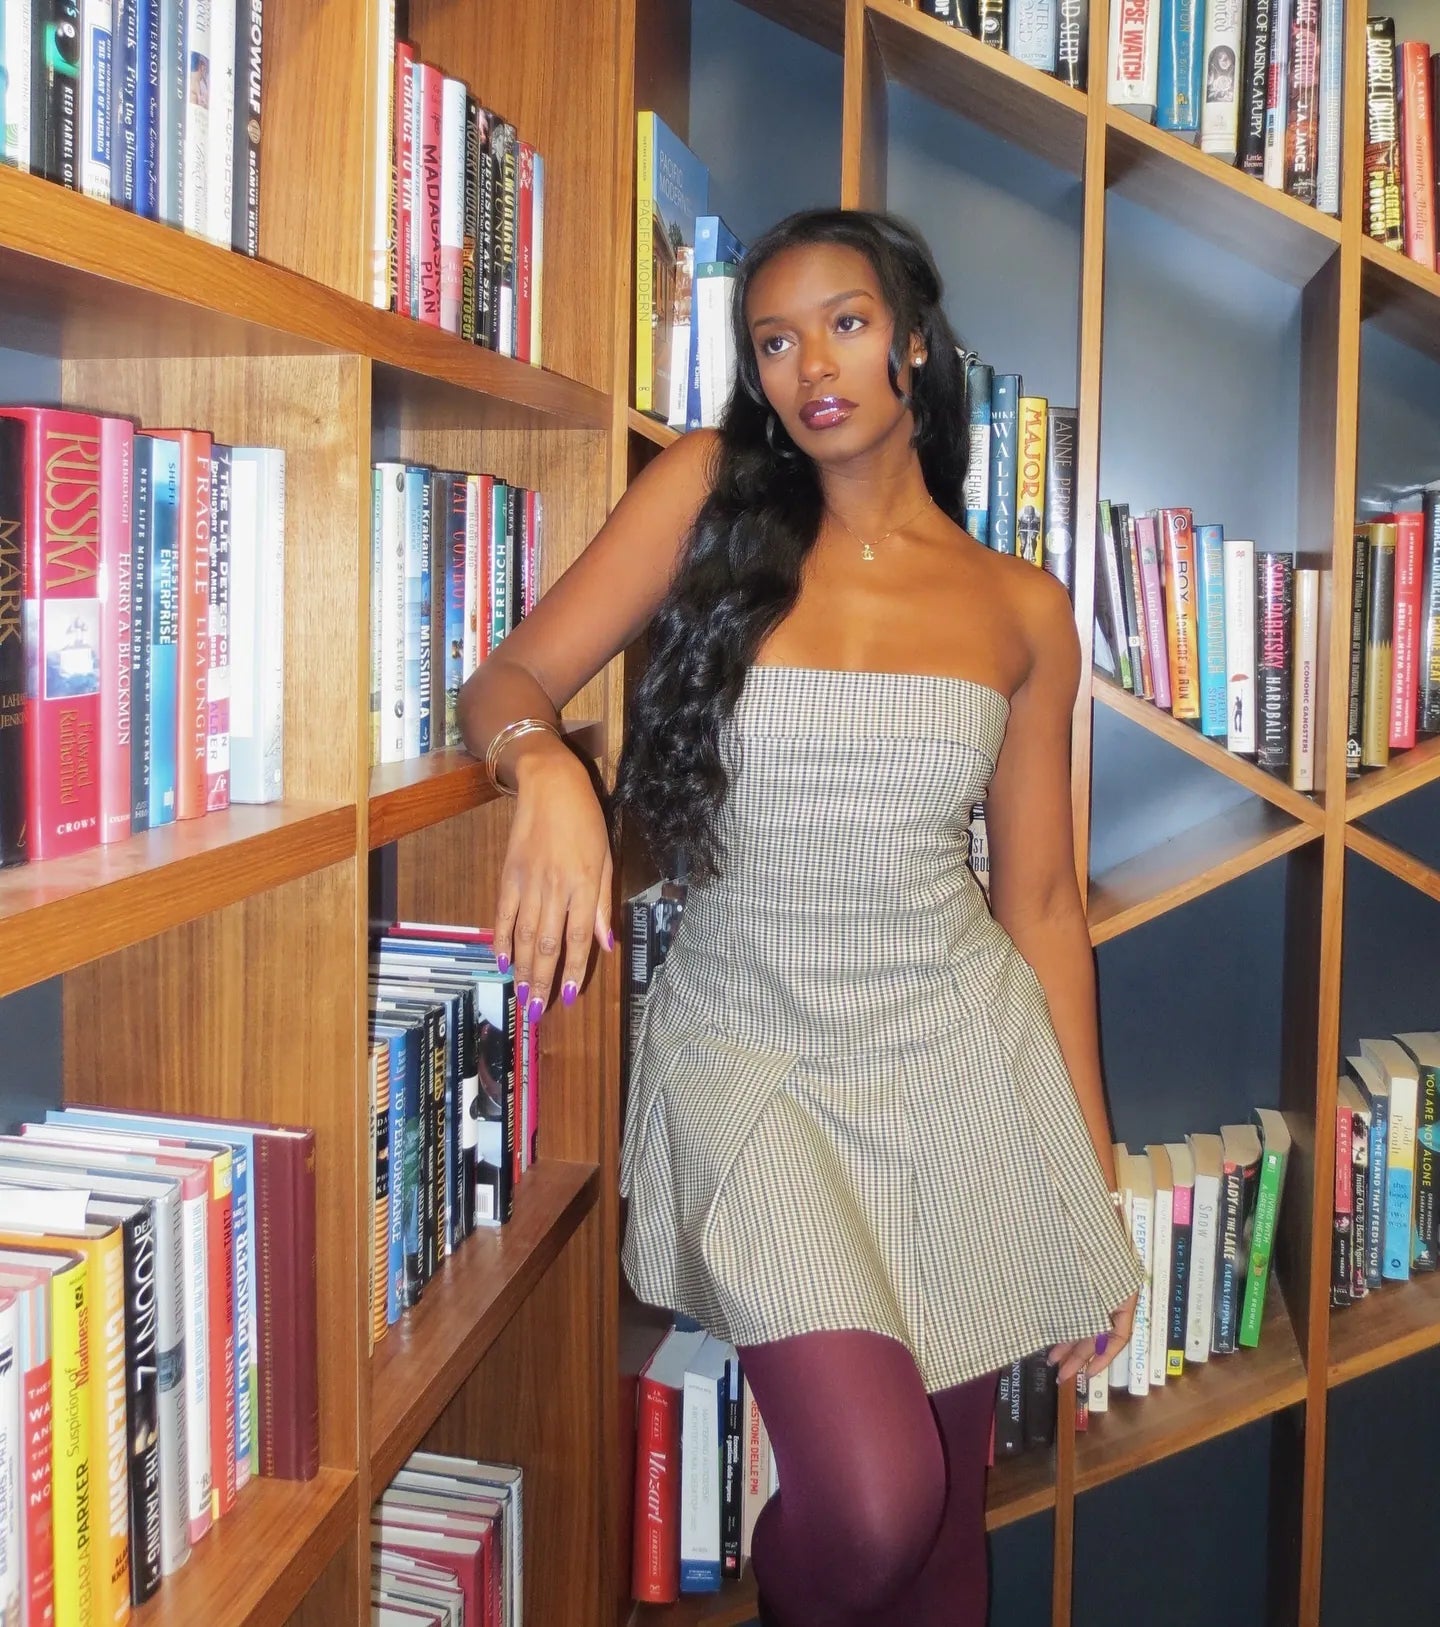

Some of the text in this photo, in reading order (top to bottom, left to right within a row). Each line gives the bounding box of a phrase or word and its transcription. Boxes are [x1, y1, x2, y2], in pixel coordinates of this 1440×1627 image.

[97, 39, 106, 60] THE
[97, 62, 106, 93] HEART
[249, 0, 262, 114] BEOWULF
[1059, 22, 1080, 64] SLEEP
[1122, 30, 1142, 82] WATCH
[1249, 13, 1267, 139] OF RAISING A PUPPY
[63, 86, 74, 160] REED FARREL
[96, 110, 106, 154] AMERICA
[124, 66, 137, 201] Pity the Billionaire
[402, 57, 412, 211] A CHANCE TO WIN
[1416, 82, 1426, 120] KARON
[248, 150, 258, 204] SEAMUS
[1294, 129, 1307, 173] JANCE
[423, 145, 441, 312] MADAGASK
[484, 154, 492, 231] DECISION
[421, 262, 437, 314] PLAN
[484, 249, 491, 271] AT
[638, 199, 651, 323] PACIFIC MODERN
[991, 410, 1016, 420] MIKE
[966, 467, 982, 510] LEHANE
[992, 423, 1014, 554] WALLACE
[1020, 406, 1042, 500] MAJOR
[1055, 421, 1073, 527] ANNE PERRY
[45, 431, 101, 590] RUSSKA
[219, 471, 231, 553] THE LIE
[421, 509, 430, 574] Krakauer
[0, 517, 23, 645] MARK
[117, 441, 132, 746] YARBROUGH HARRY A. BLACKMUN
[132, 467, 148, 671] NEXT LIFE MIGHT BE KINDER
[159, 549, 172, 646] ENTERPRISE
[170, 551, 178, 645] RESILIENT
[495, 544, 506, 618] FRENCH
[1175, 560, 1190, 603] BOX
[194, 456, 210, 761] FRAGILE LISA UNGER
[1174, 612, 1190, 661] NOWHERE
[1205, 590, 1226, 675] EVANOVICH
[1264, 597, 1286, 669] PARETSKY
[420, 625, 431, 719] MISSOULA
[1176, 678, 1190, 700] RUN
[1301, 660, 1310, 753] ECONOMIC GANGSTERS
[1394, 602, 1407, 739] THE MAN WHO WASN'T THERE
[1264, 676, 1282, 742] HARDBALL
[56, 815, 97, 836] CROWN
[394, 1087, 406, 1111] TO
[1421, 1073, 1435, 1187] YOU ARE NOT ALONE
[392, 1115, 405, 1244] PERFORMANCE
[1370, 1138, 1384, 1266] THE HAND THAT FEEDS YOU
[223, 1208, 233, 1249] THAT?
[1223, 1175, 1240, 1259] LADY IN THE LAKE
[1254, 1192, 1268, 1248] GREEN HEART
[1263, 1193, 1275, 1243] LIVING WITH
[1354, 1173, 1366, 1268] Inside Out Back Again
[236, 1229, 250, 1349] PROSPER
[1219, 1263, 1235, 1337] LAURA LIPPMAN
[1247, 1298, 1258, 1329] BROWNE
[75, 1306, 89, 1391] Madness
[1134, 1294, 1146, 1368] EVERYTHING
[238, 1347, 250, 1391] TO
[1000, 1376, 1010, 1401] NEIL
[66, 1384, 82, 1457] Suspicion
[223, 1335, 238, 1503] DEBORAH TANNEN
[238, 1391, 251, 1452] HOW
[749, 1399, 761, 1496] GESTIONE DELLE PMI
[77, 1459, 90, 1550] PARKER
[145, 1446, 160, 1489] THE
[647, 1451, 667, 1524] Mozart
[146, 1486, 160, 1564] TAKING
